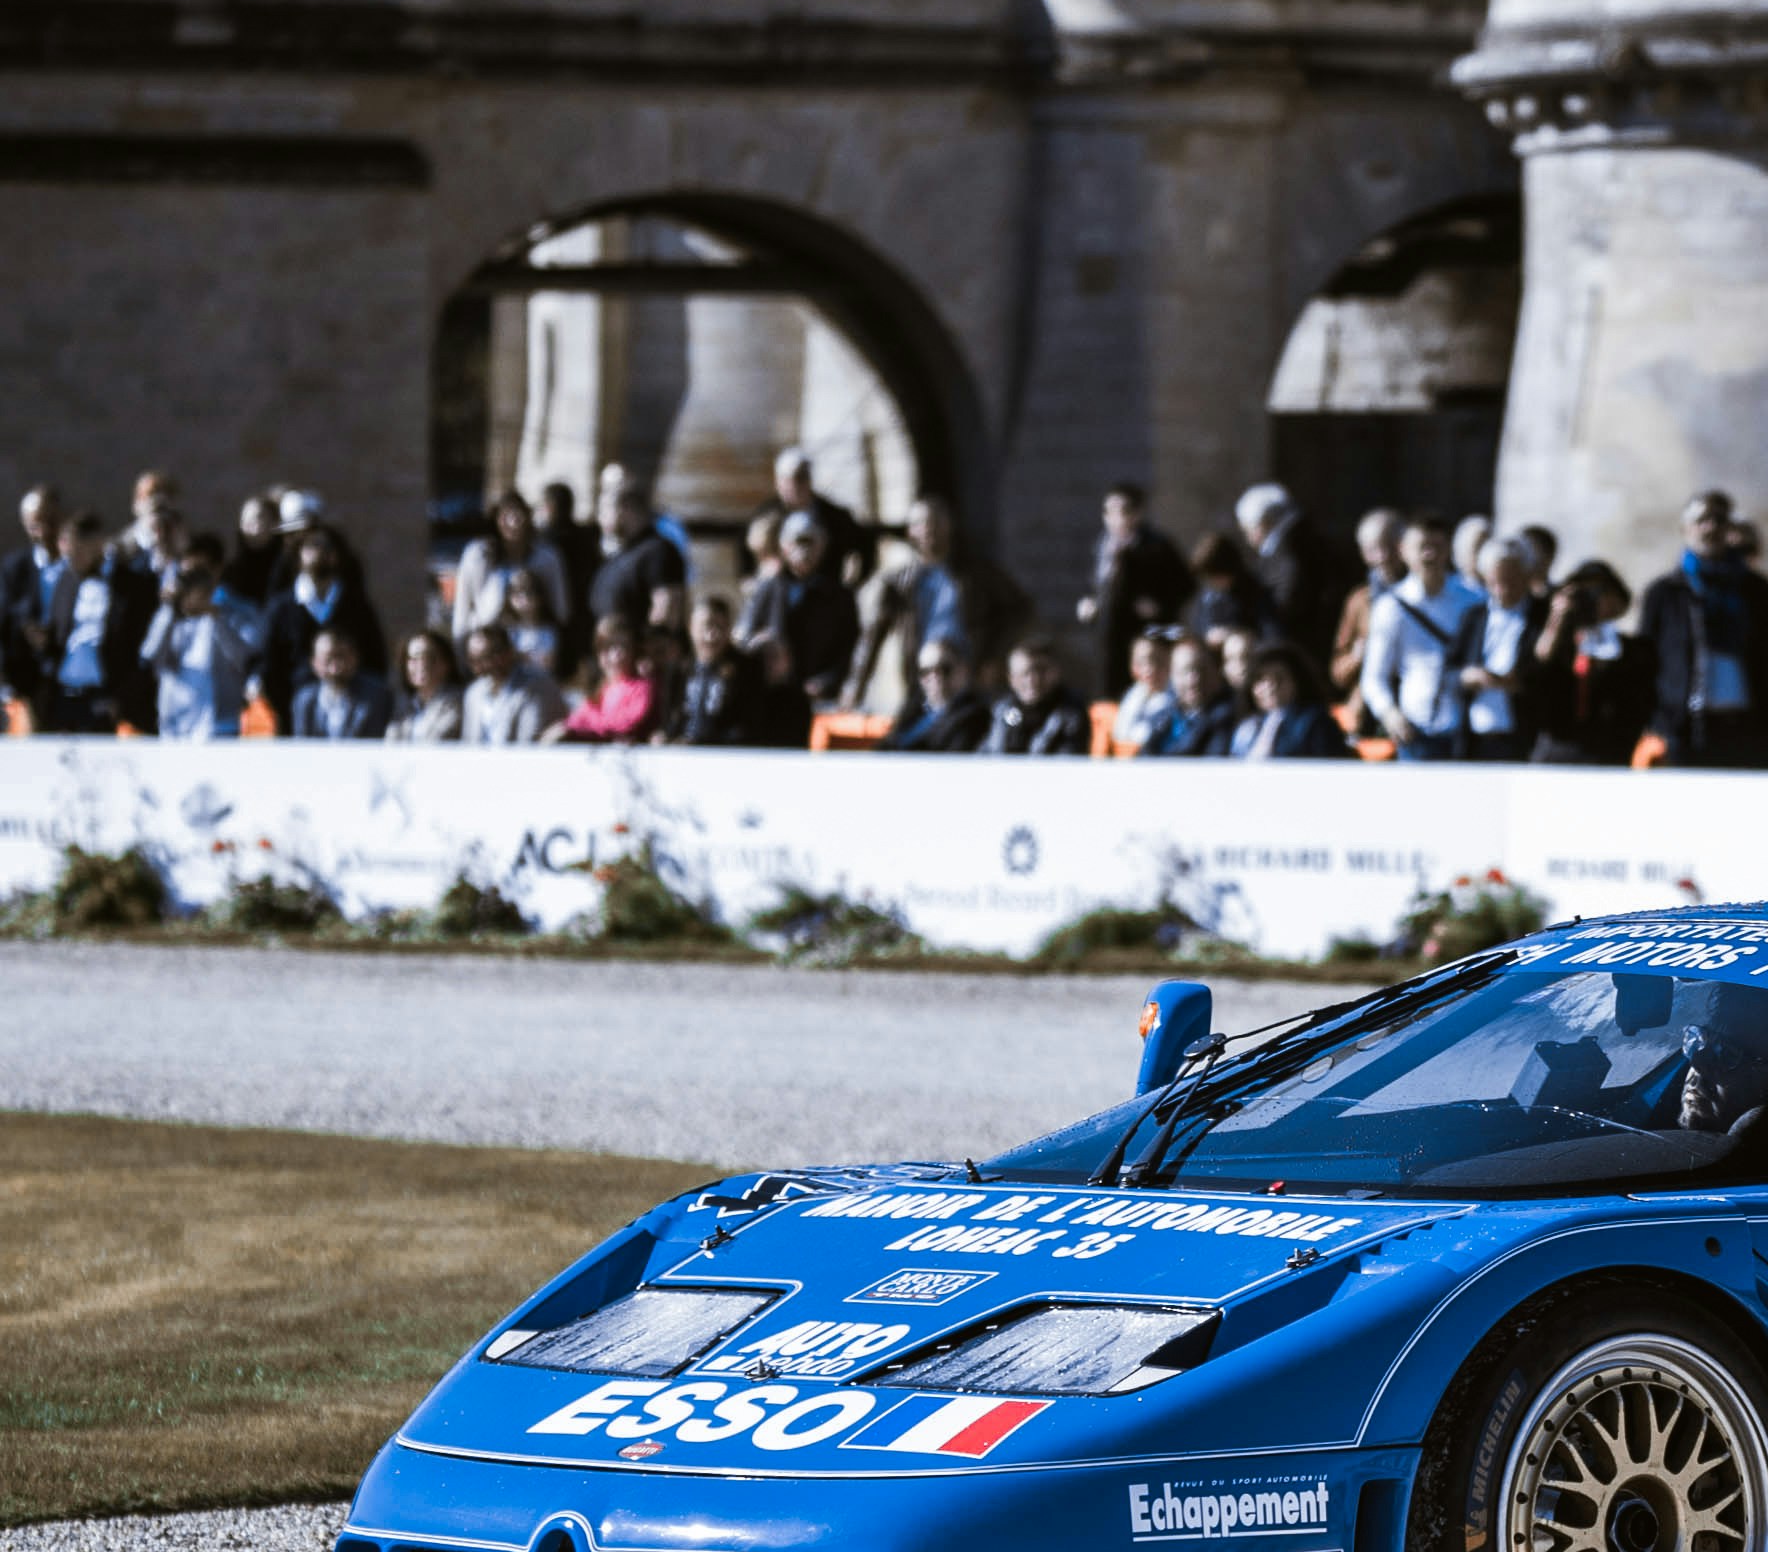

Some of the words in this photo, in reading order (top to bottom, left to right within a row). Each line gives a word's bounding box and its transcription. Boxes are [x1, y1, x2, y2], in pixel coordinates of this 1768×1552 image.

[1560, 941, 1759, 970] MOTORS
[800, 1191, 988, 1219] MANOIR
[969, 1195, 1057, 1222] DE
[1036, 1196, 1363, 1242] L'AUTOMOBILE
[882, 1225, 1069, 1255] LOHEAC
[1052, 1231, 1137, 1259] 35
[876, 1281, 960, 1296] CARLO
[893, 1272, 977, 1287] MONTE
[737, 1320, 911, 1359] AUTO
[525, 1380, 877, 1451] ESSO
[1471, 1379, 1522, 1503] MICHELIN
[1174, 1480, 1205, 1489] REVUE
[1232, 1477, 1263, 1486] SPORT
[1266, 1474, 1329, 1485] AUTOMOBILE
[1129, 1482, 1330, 1539] Echappement
